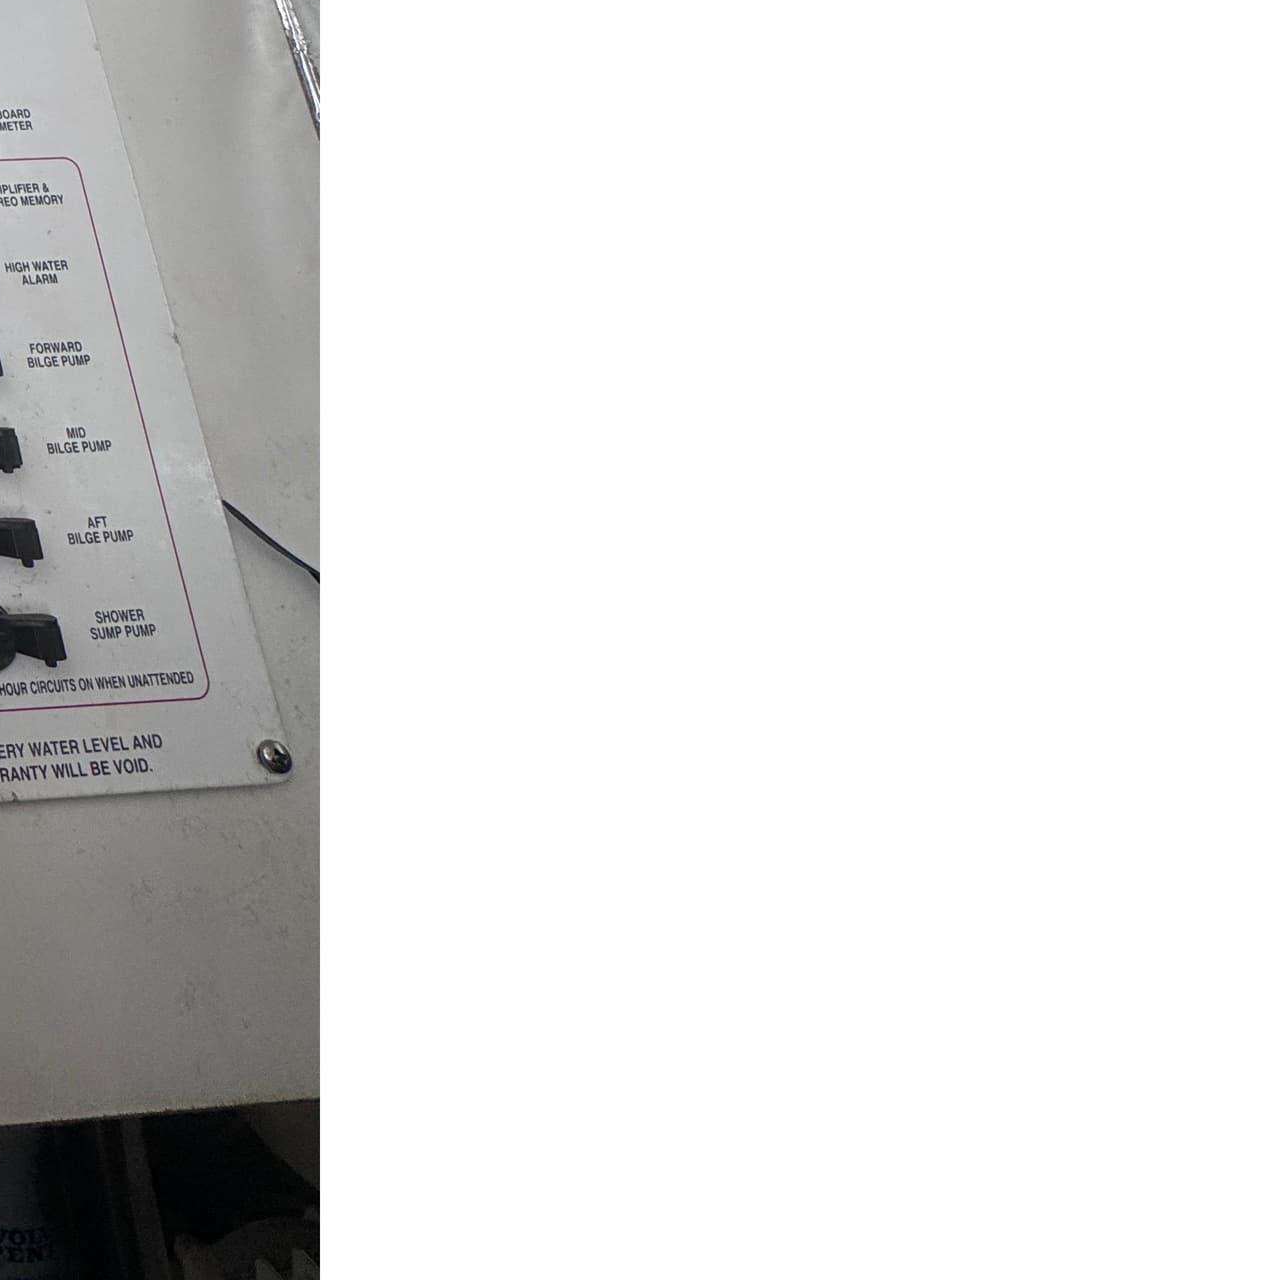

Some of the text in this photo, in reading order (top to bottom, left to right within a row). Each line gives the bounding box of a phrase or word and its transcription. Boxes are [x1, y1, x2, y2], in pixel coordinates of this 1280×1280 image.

[42, 183, 49, 193] &
[20, 195, 64, 207] MEMORY
[4, 260, 69, 273] HIGH WATER
[22, 274, 58, 285] ALARM
[29, 341, 82, 354] FORWARD
[27, 354, 91, 368] BILGE PUMP
[66, 427, 86, 438] MID
[47, 440, 112, 455] BILGE PUMP
[88, 516, 107, 528] AFT
[67, 530, 134, 545] BILGE PUMP
[94, 609, 145, 624] SHOWER
[90, 624, 156, 640] SUMP PUMP
[30, 679, 77, 695] CIRCUITS
[78, 677, 95, 691] ON
[96, 675, 126, 690] WHEN
[127, 671, 194, 688] UNATTENDED
[28, 739, 81, 758] WATER
[83, 736, 130, 753] LEVEL
[132, 733, 163, 750] AND
[50, 763, 87, 780] WILL
[90, 761, 109, 776] BE
[112, 758, 153, 774] VOID.
